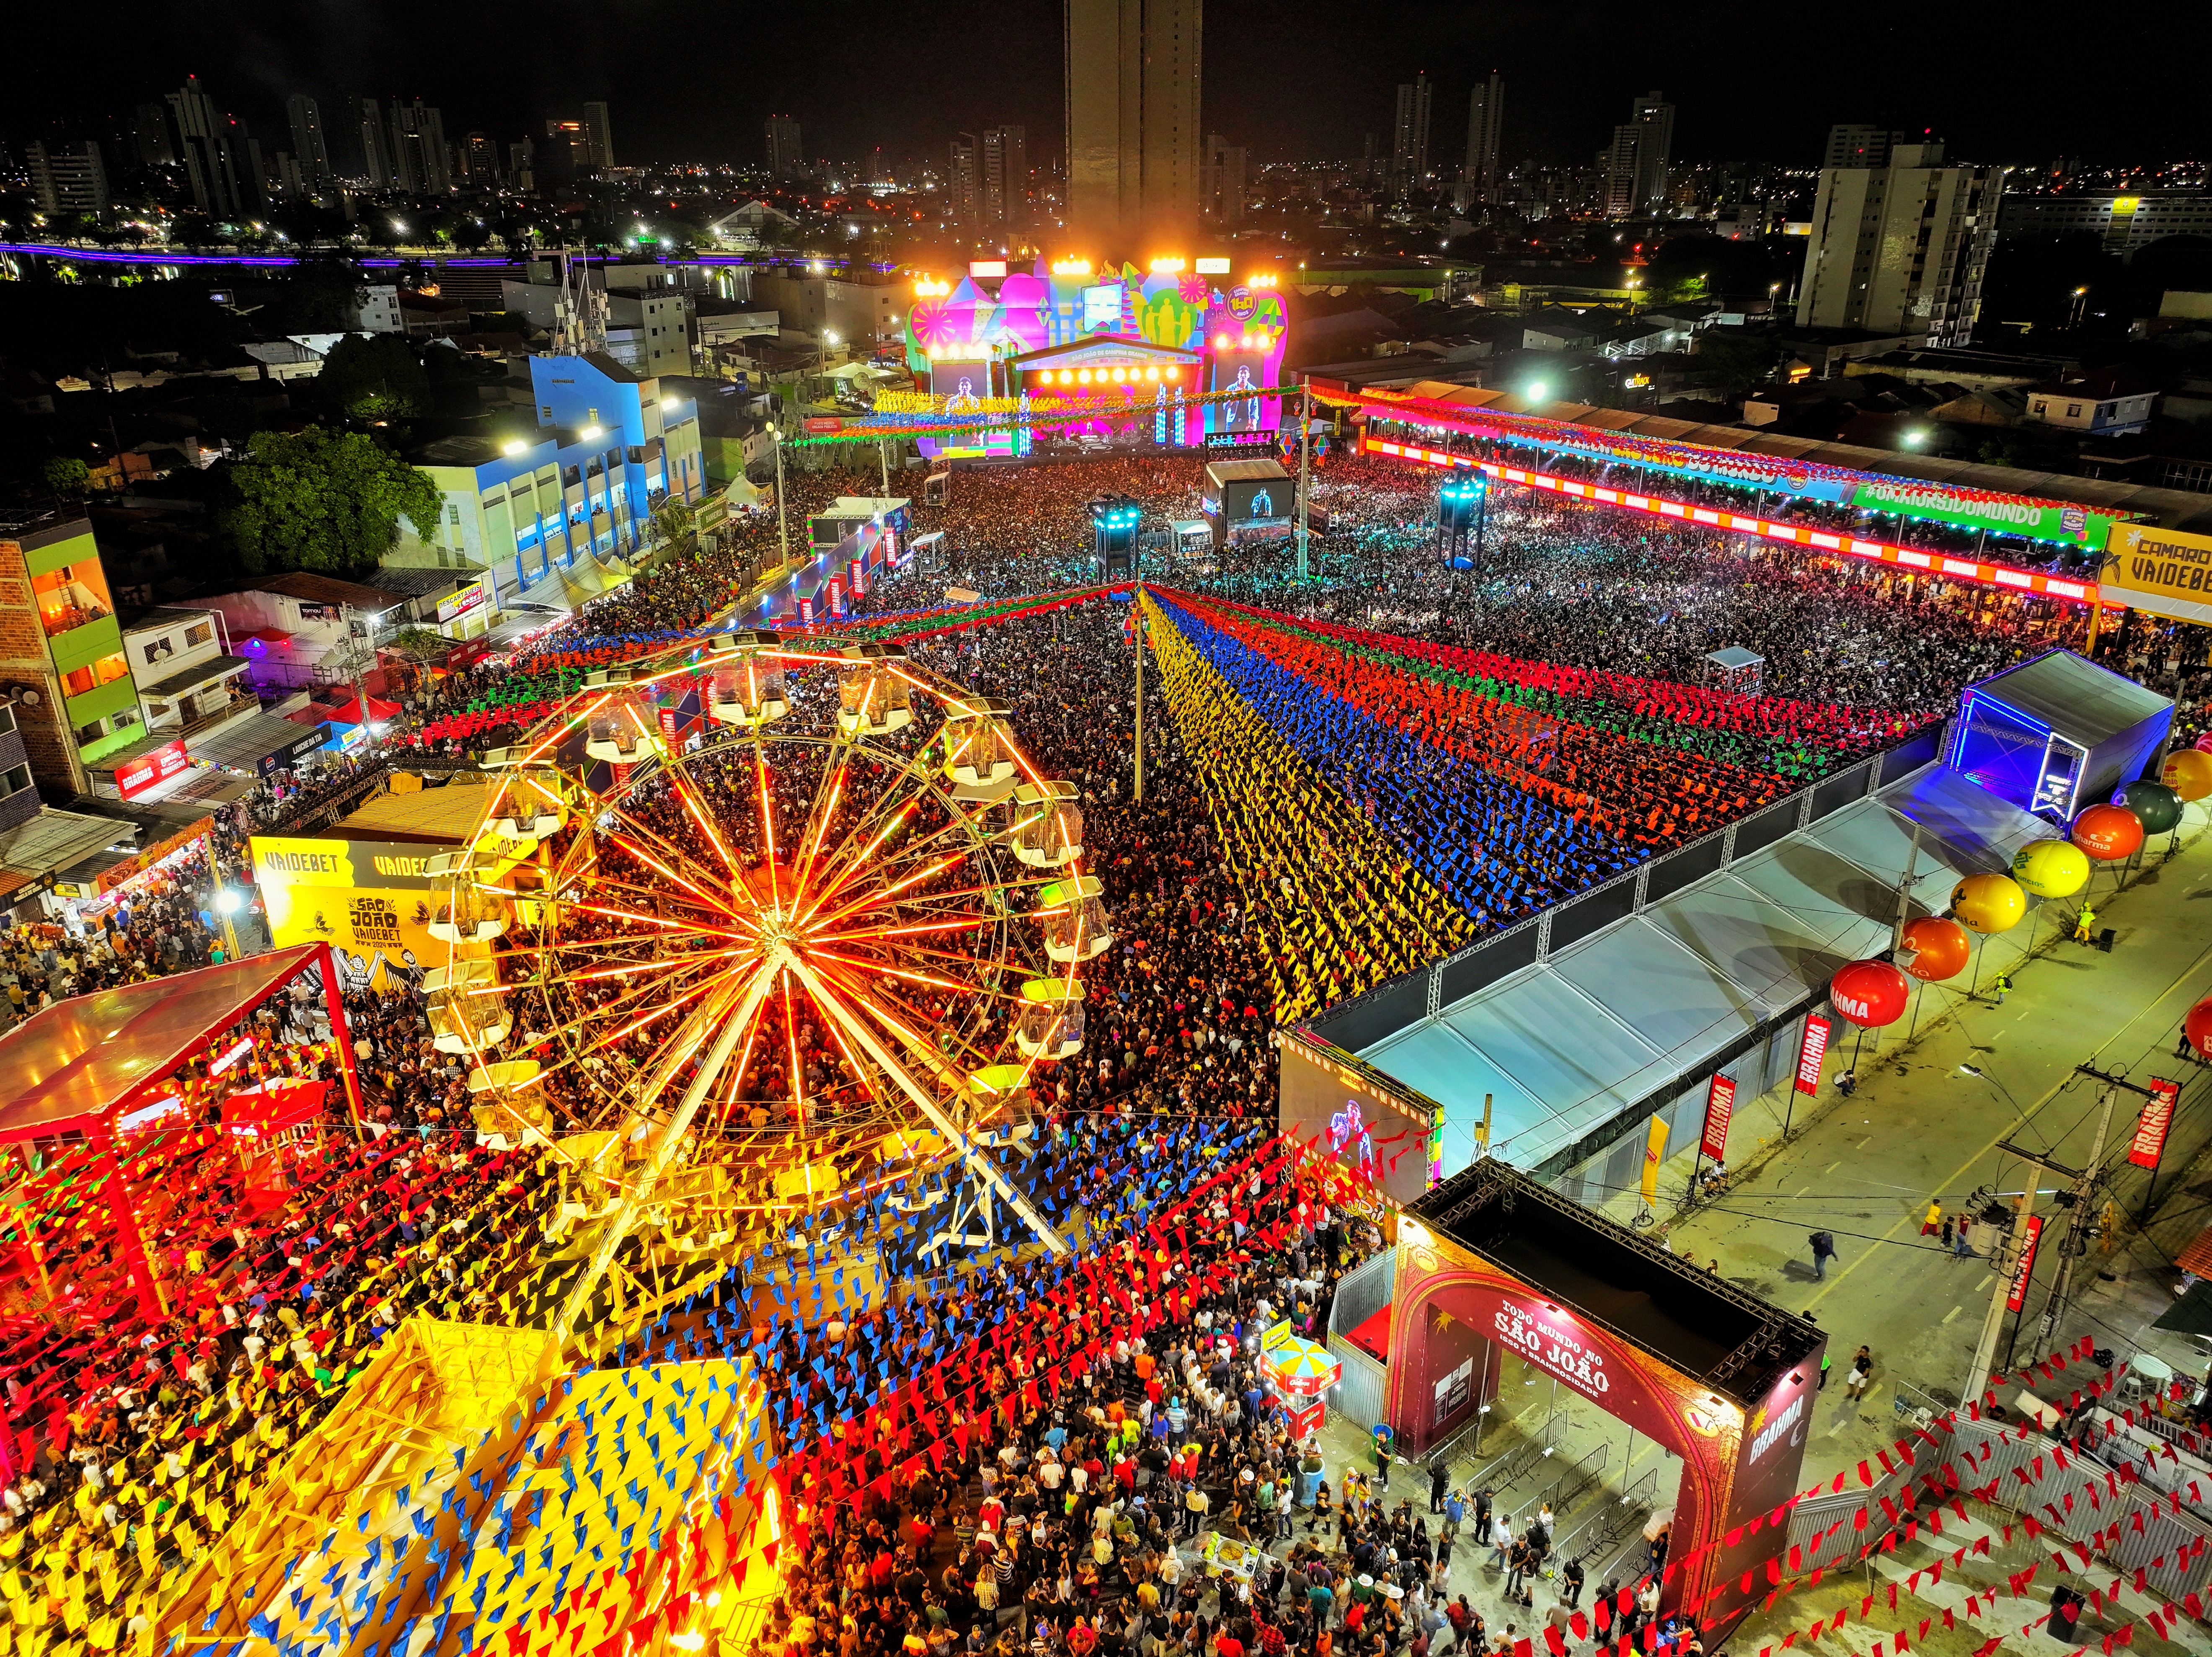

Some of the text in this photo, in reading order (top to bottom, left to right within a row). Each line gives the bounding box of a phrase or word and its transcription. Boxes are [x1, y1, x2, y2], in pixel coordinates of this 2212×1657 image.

[1230, 297, 1253, 311] 160
[1128, 350, 1148, 359] GRANDE
[886, 533, 895, 562] BRAHMA
[853, 563, 863, 593] BRAHMA
[831, 582, 840, 613] BRAHMA
[292, 733, 323, 755] LANCHE DA TIA
[265, 852, 338, 873] VAIDEBET
[357, 897, 385, 912] SÃO
[353, 927, 401, 942] VAIDEBET
[1799, 1024, 1828, 1085] BRAHMA
[1706, 1084, 1733, 1150] BRAHMA
[2133, 1090, 2173, 1156] BRAHMA
[1503, 1299, 1603, 1367] TODO MUNDO NO
[1495, 1312, 1610, 1392] SÃO JOÃO
[1499, 1333, 1599, 1398] ISSO É BRAHMOSIDADE
[1302, 1410, 1320, 1426] Churros
[1749, 1394, 1804, 1466] BRAHMA
